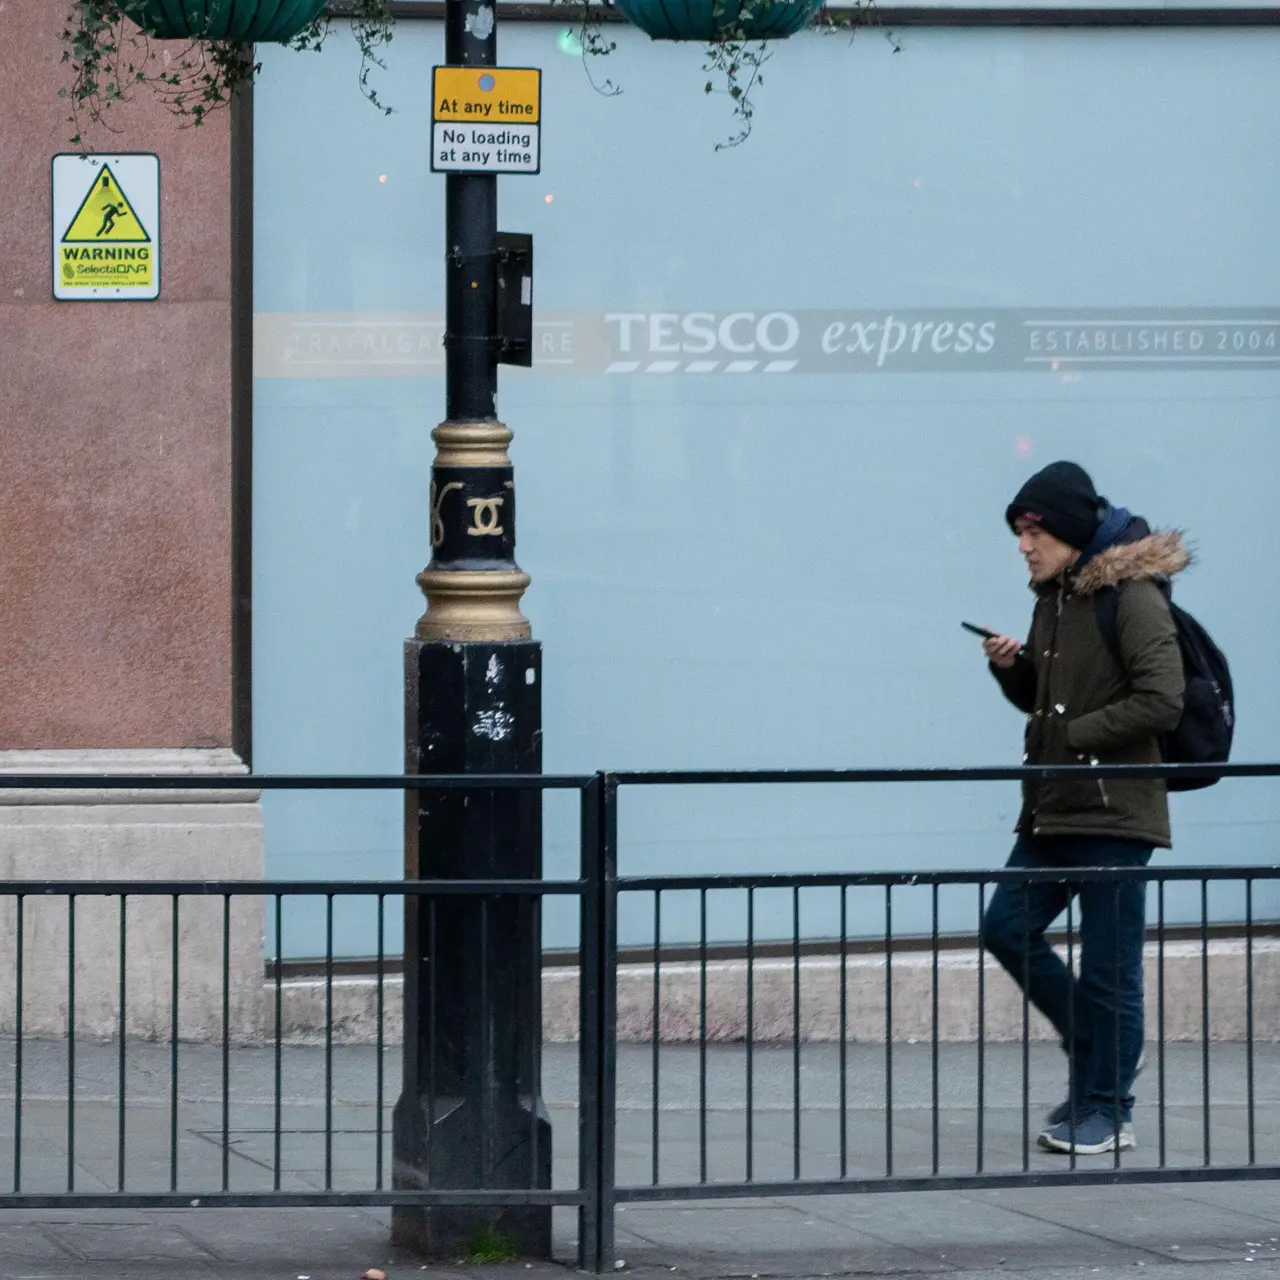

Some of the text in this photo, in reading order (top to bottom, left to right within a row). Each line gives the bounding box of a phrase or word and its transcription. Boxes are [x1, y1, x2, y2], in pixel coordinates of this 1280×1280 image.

[439, 99, 534, 116] At any time
[443, 130, 531, 148] No loading
[440, 149, 531, 165] at any time
[63, 248, 149, 260] WARNING
[291, 332, 444, 353] TRAFALGA
[605, 312, 800, 353] TESCO
[822, 315, 996, 367] express
[1030, 330, 1275, 352] ESTABLISHED 2004
